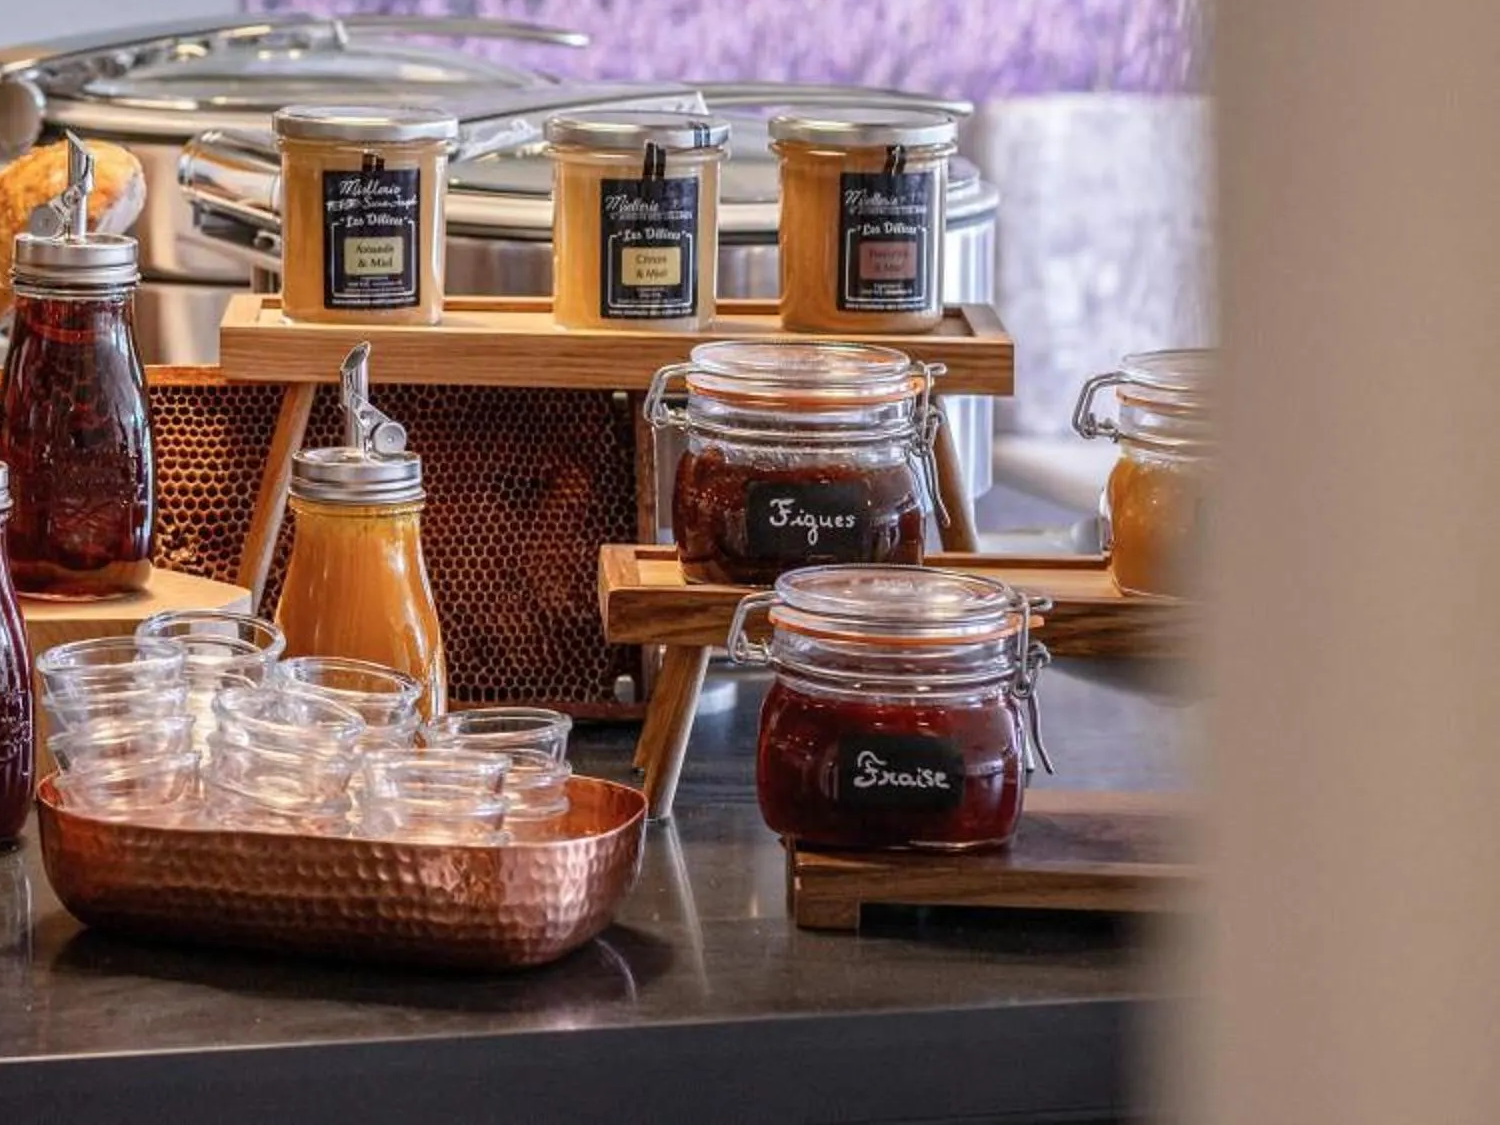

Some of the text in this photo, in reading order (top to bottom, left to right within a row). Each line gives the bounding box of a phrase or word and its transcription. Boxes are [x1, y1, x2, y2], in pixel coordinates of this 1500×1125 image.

[371, 257, 393, 268] Miel
[769, 498, 857, 546] Figues
[853, 750, 951, 789] Fraise
